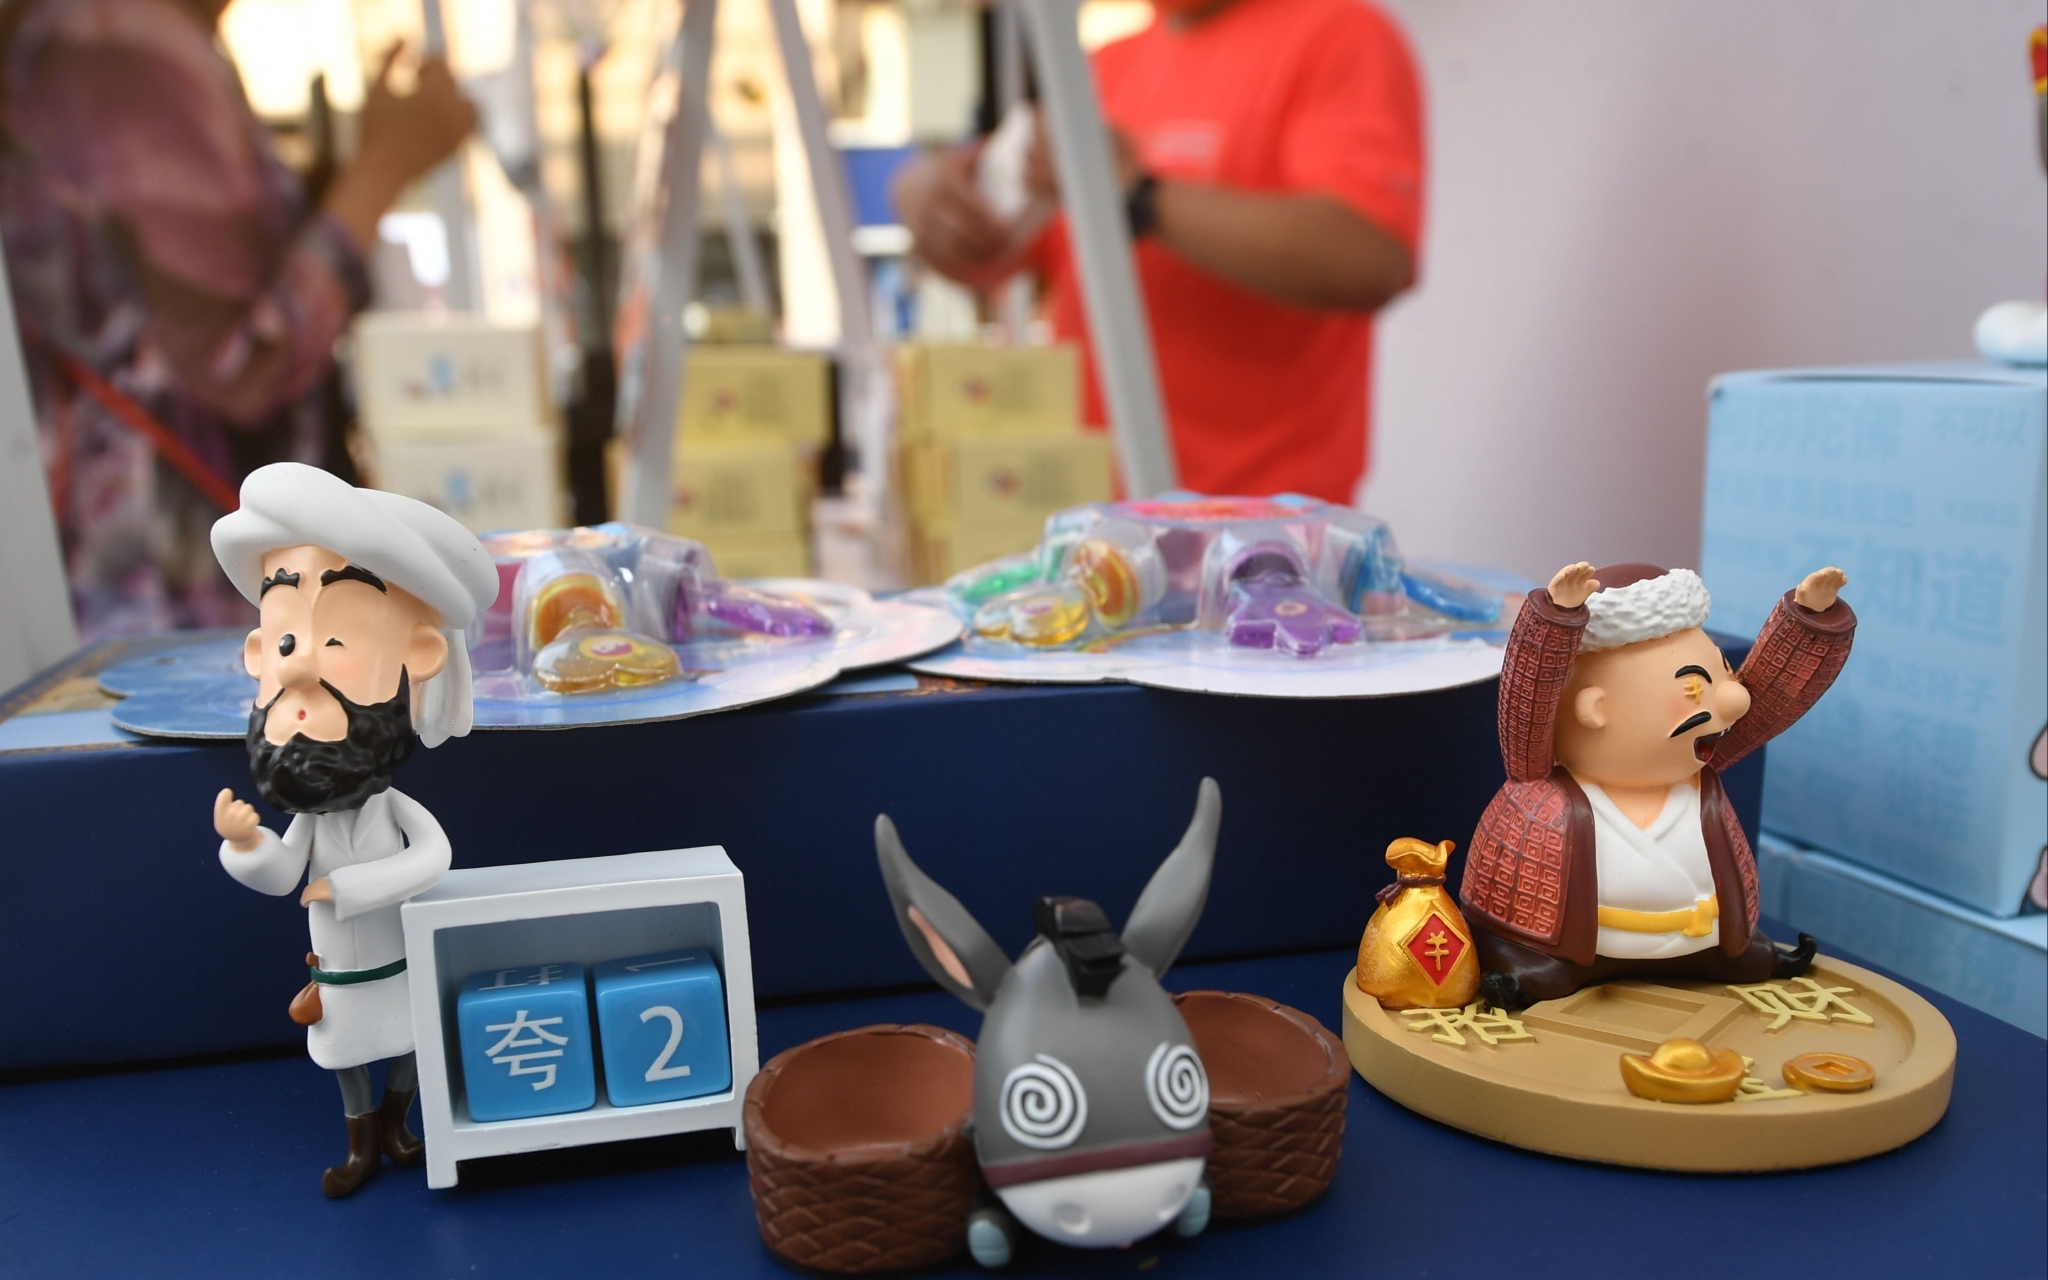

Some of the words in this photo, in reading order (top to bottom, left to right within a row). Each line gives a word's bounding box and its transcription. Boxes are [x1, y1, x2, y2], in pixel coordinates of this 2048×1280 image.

[1726, 976, 1875, 1032] 财
[485, 1009, 569, 1092] 夸
[639, 1005, 691, 1083] 2
